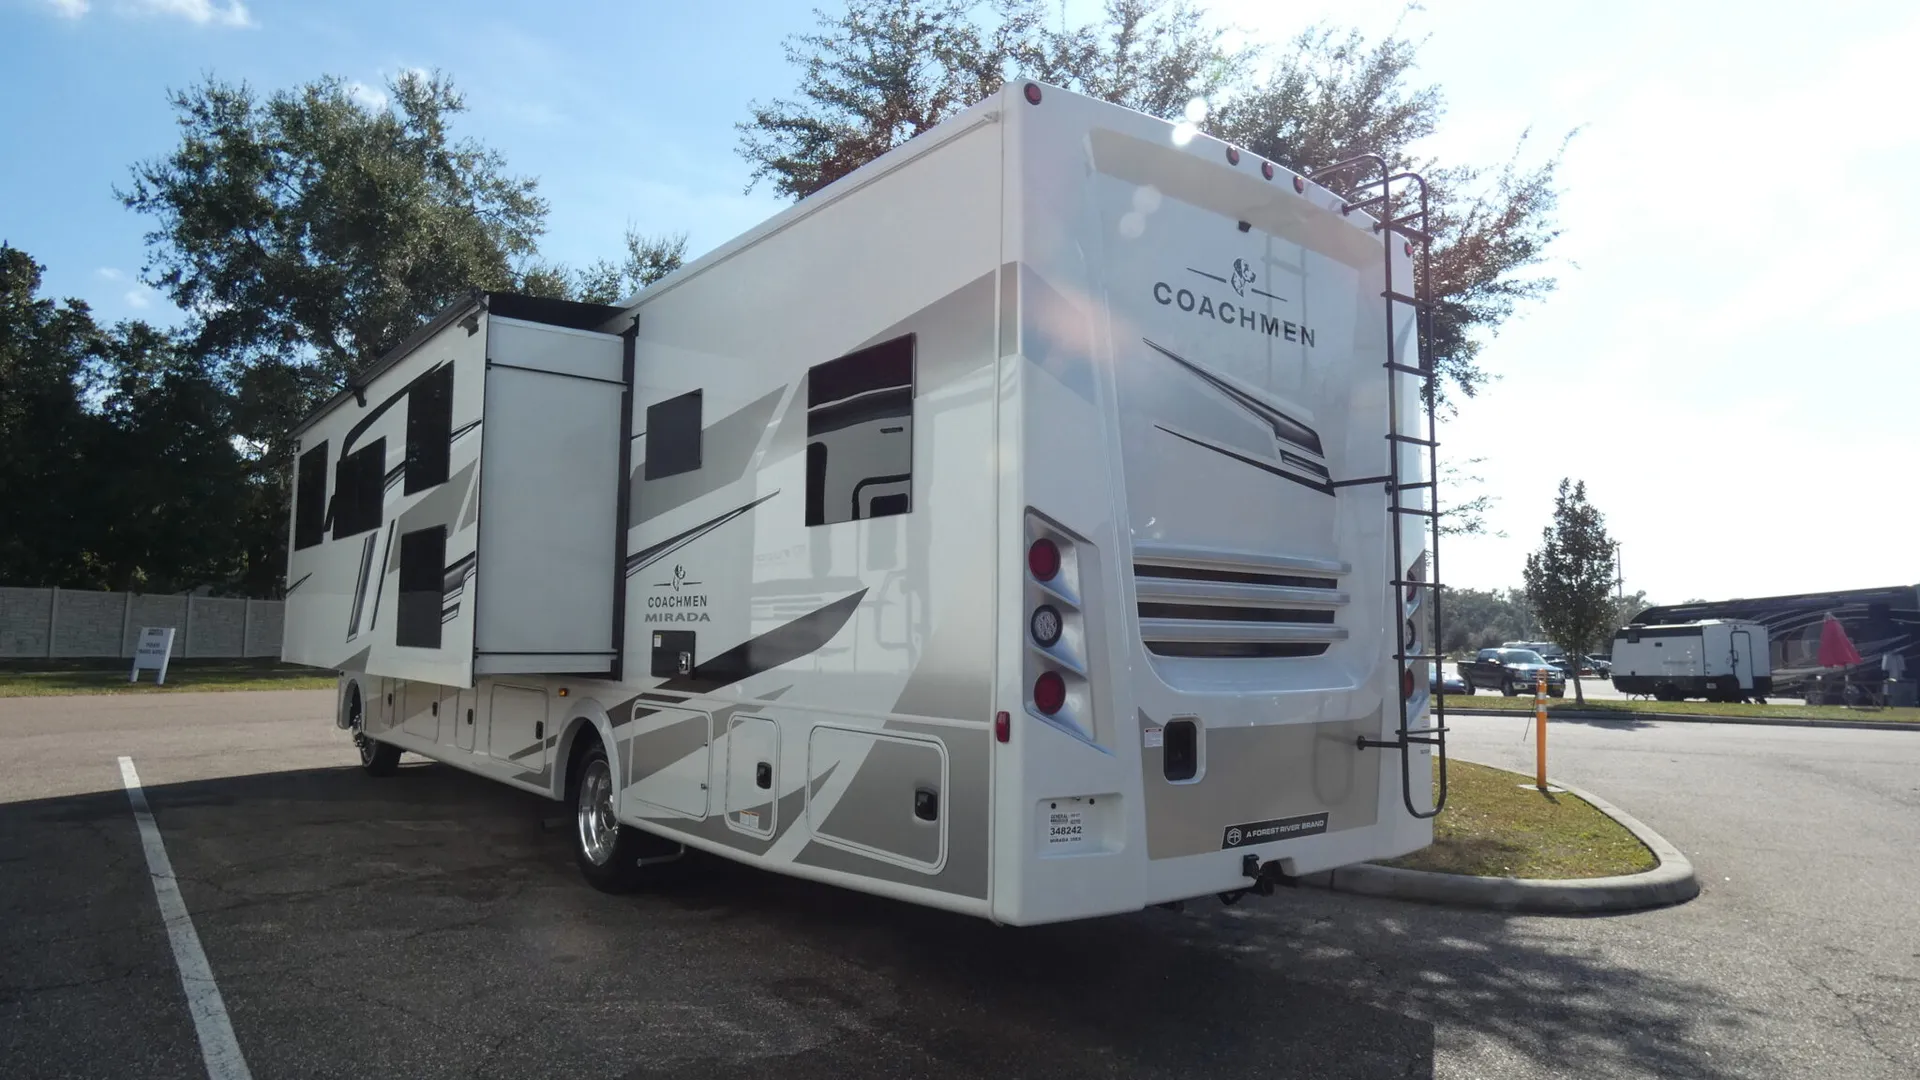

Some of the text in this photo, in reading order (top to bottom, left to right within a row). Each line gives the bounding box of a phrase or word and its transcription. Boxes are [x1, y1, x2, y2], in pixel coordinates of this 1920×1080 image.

[1153, 281, 1315, 348] COACHMEN
[648, 596, 707, 608] COACHMEN
[645, 612, 710, 622] MIRADA
[1050, 826, 1082, 836] 348242
[1252, 827, 1279, 837] FOREST
[1280, 824, 1300, 832] RIVER
[1301, 820, 1324, 830] BRAND
